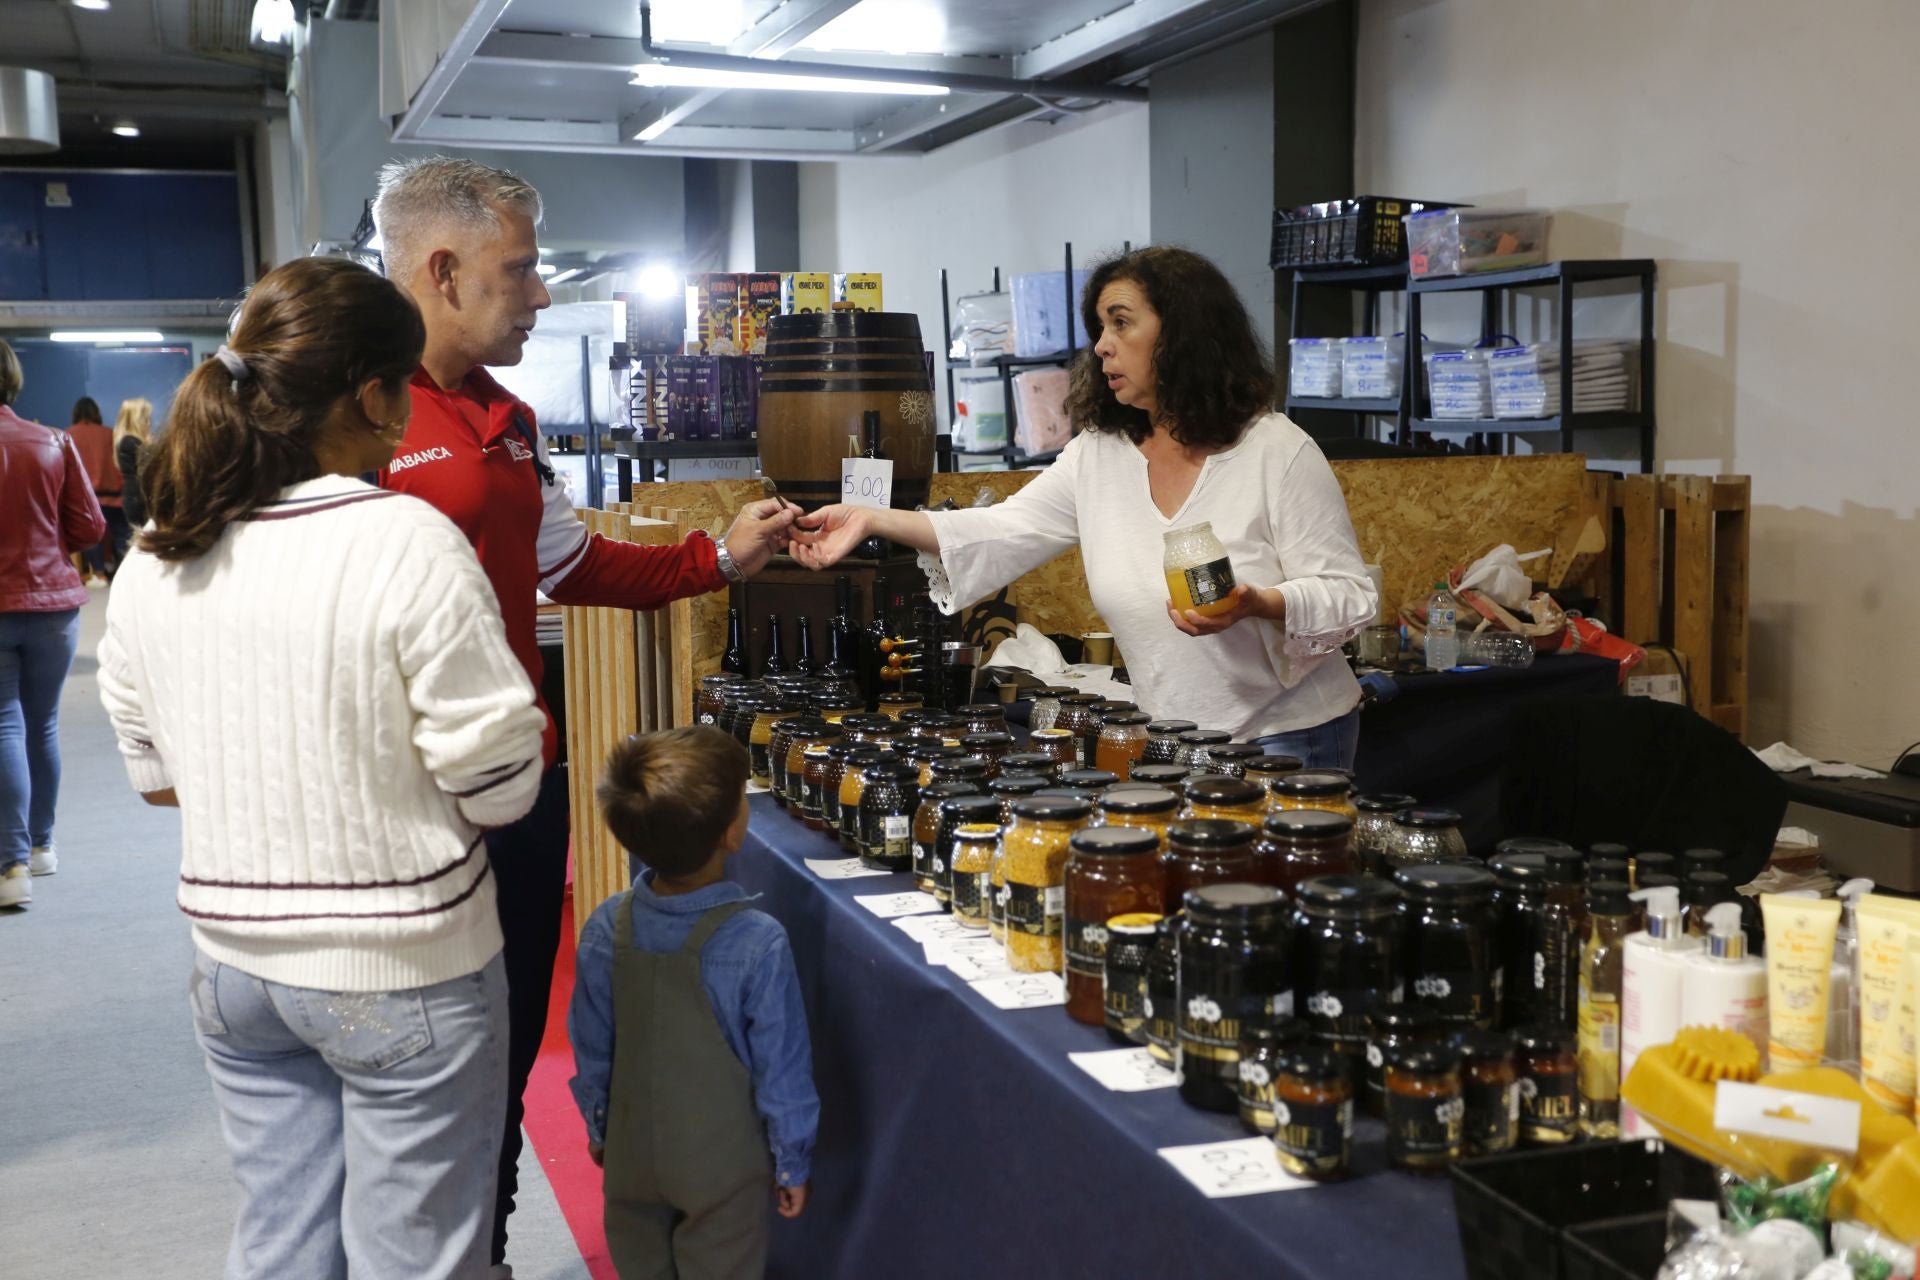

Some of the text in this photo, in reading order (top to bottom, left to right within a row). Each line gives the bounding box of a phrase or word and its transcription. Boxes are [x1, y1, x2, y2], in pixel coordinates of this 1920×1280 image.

[630, 358, 647, 441] MINIX
[655, 356, 669, 441] MINIX
[395, 446, 453, 471] ABANCA
